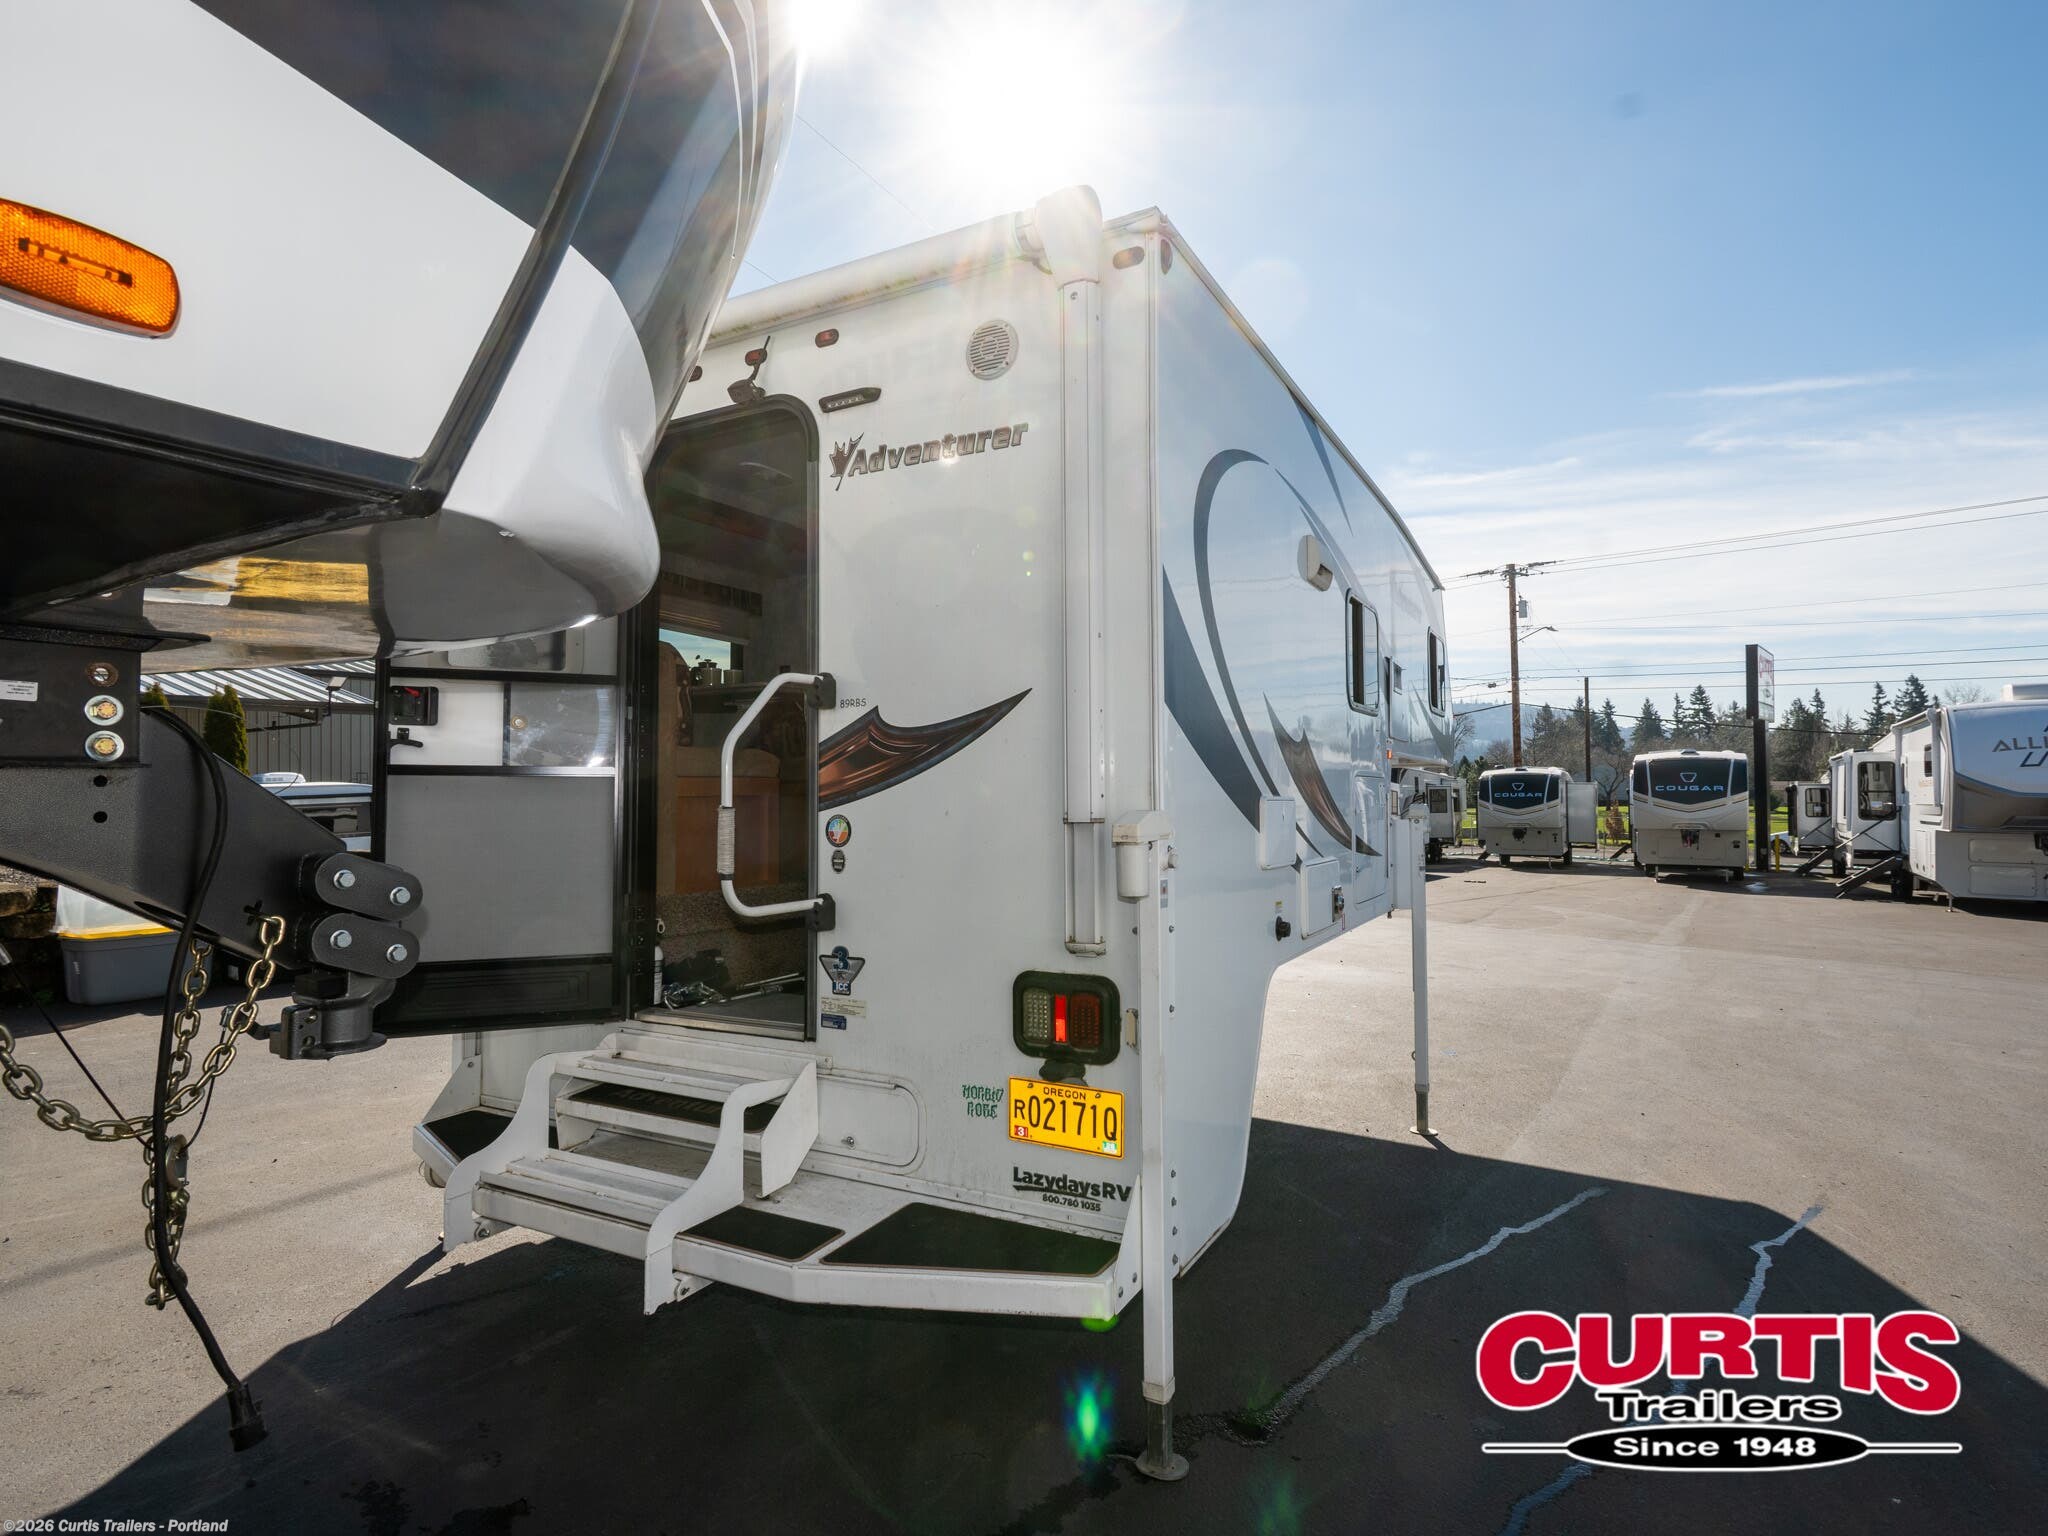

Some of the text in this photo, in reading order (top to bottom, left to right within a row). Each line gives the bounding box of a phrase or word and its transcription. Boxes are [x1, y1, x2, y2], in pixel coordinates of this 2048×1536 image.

[848, 422, 1029, 477] Adventurer
[1655, 784, 1724, 792] COUGAR
[1043, 1086, 1086, 1101] OREGON
[1081, 1199, 1102, 1212] 1035
